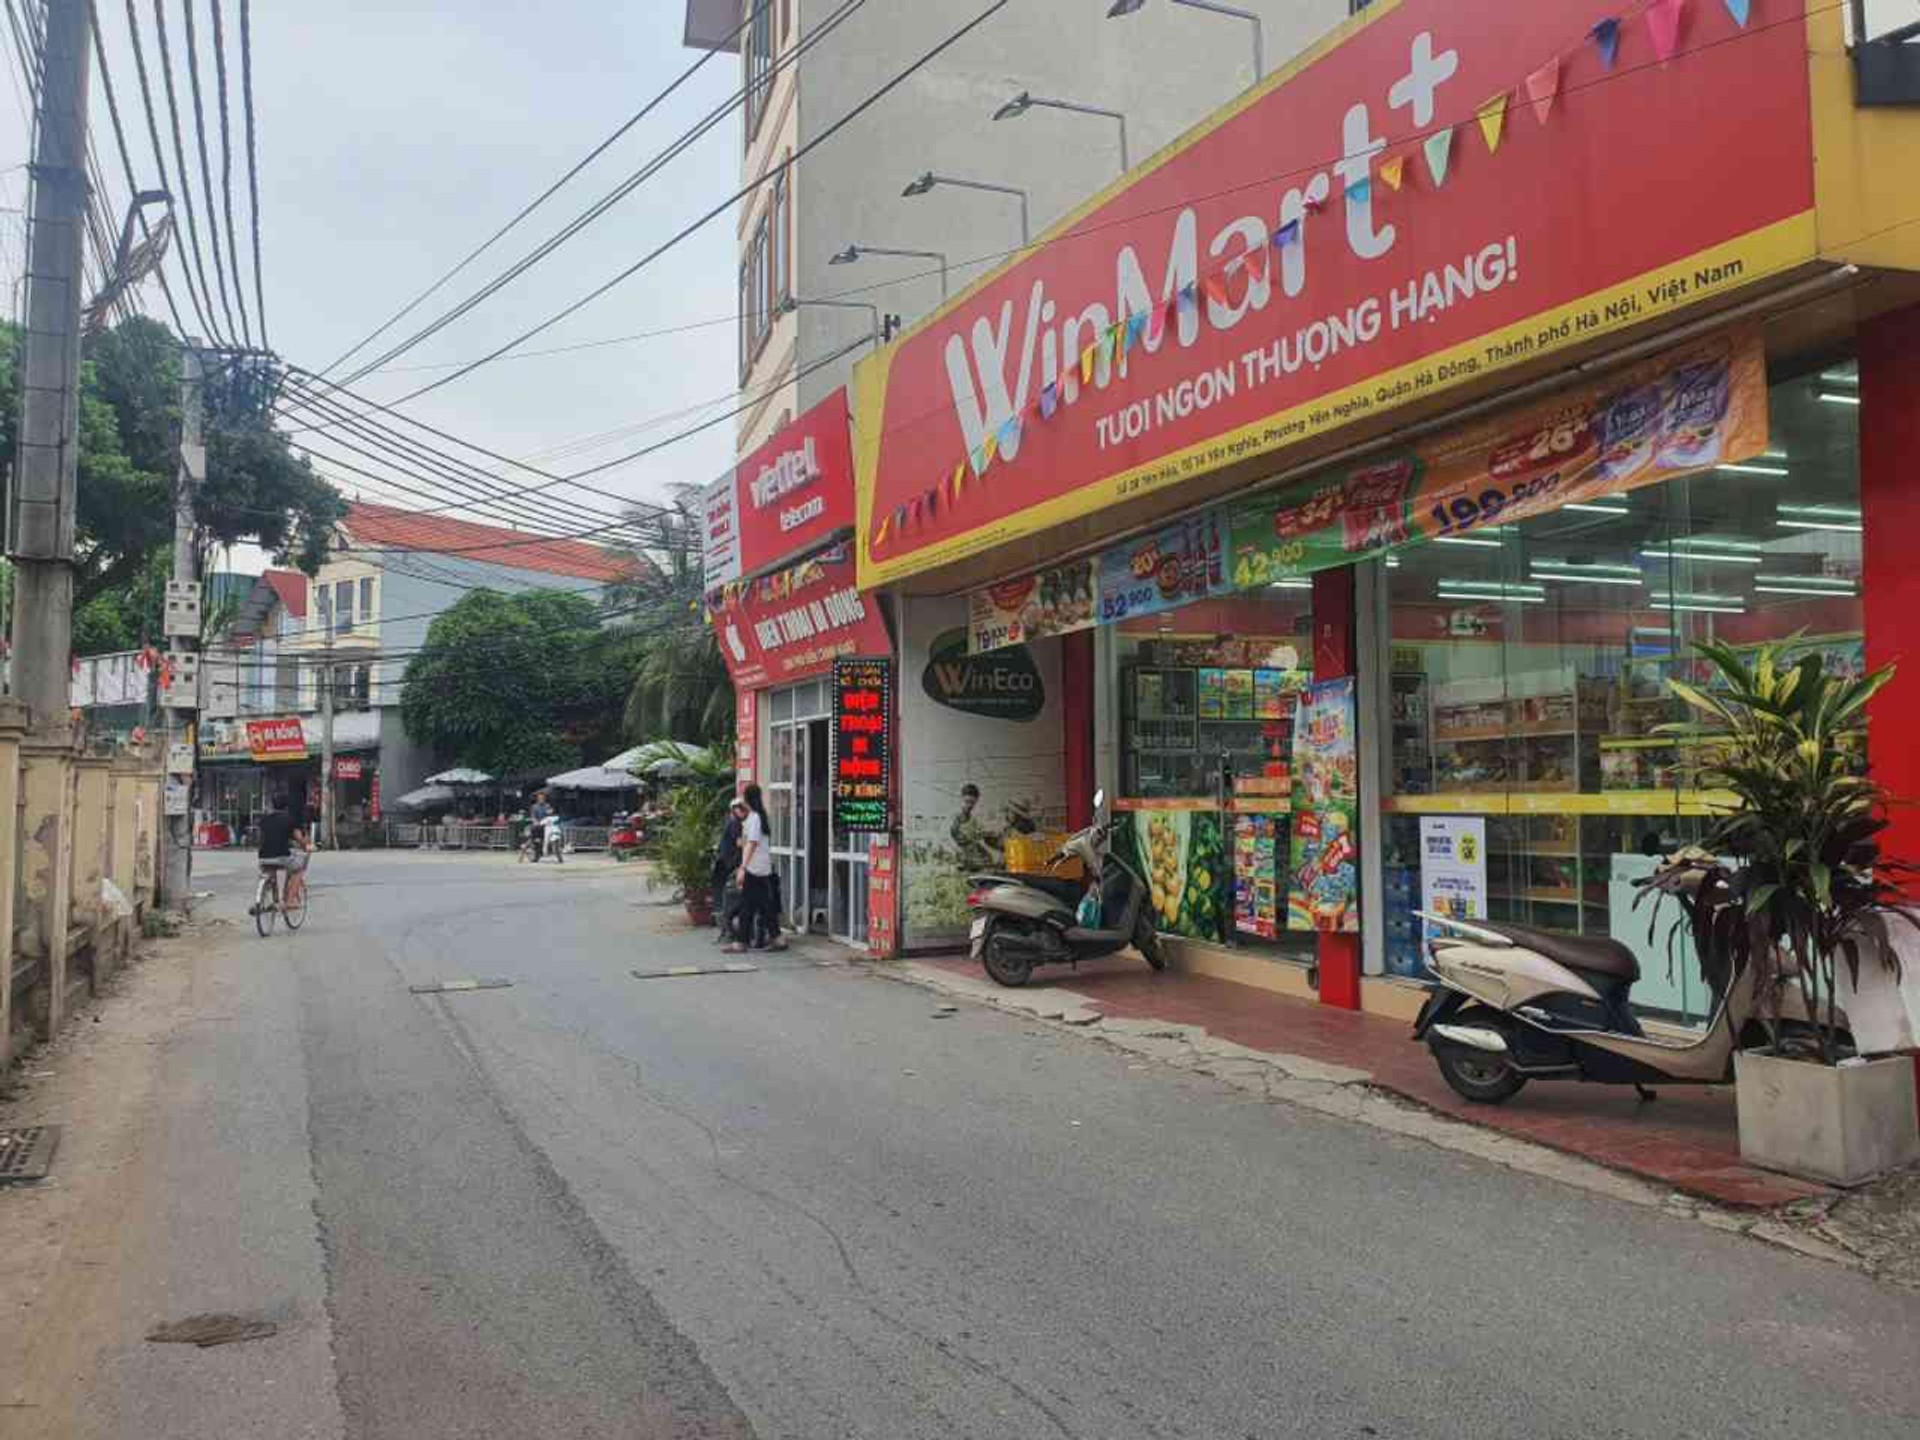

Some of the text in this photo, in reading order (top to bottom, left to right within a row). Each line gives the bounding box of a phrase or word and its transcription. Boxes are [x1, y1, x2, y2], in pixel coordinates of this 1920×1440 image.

[1156, 360, 1236, 427] NGON
[1241, 298, 1383, 389] THƯỢNG
[1389, 235, 1519, 329] HẠNG!
[1415, 372, 1434, 389] Hà
[1437, 355, 1482, 381] Đông,
[1485, 336, 1535, 364] Thành
[1537, 317, 1570, 349] phố
[1575, 307, 1600, 336] Hà
[1604, 294, 1642, 323] Nội,
[1647, 278, 1688, 305] Việt
[1694, 258, 1744, 286] Nam
[934, 662, 1033, 696] WinEco
